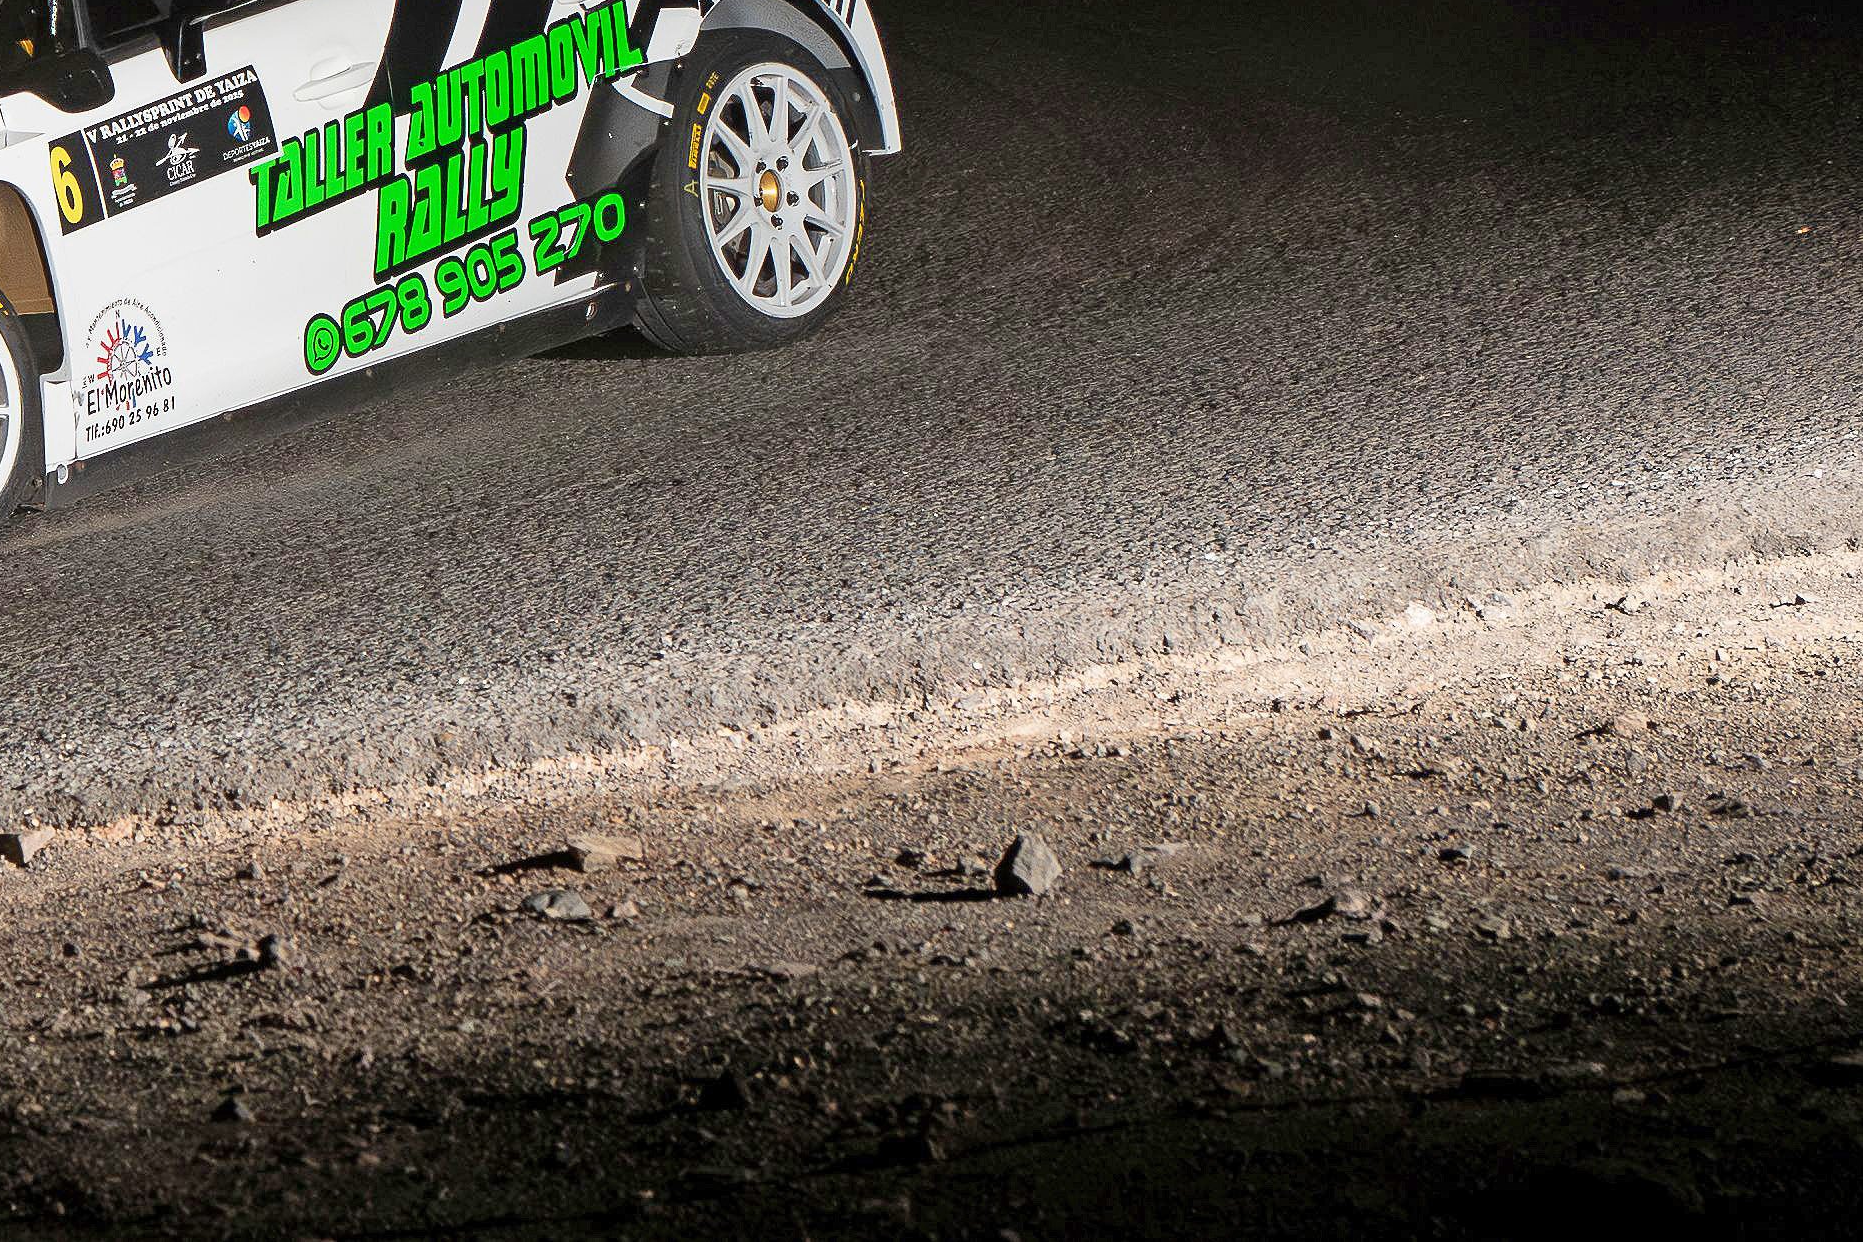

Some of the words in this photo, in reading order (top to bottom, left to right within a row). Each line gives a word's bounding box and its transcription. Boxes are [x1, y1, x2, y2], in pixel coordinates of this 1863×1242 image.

[86, 129, 97, 144] V
[100, 92, 193, 139] RALLYSPRINT
[194, 85, 216, 103] DE
[214, 70, 258, 94] YAIZA
[148, 122, 160, 132] de
[160, 103, 210, 127] noviembre
[210, 99, 223, 108] de
[222, 89, 244, 104] 2025
[251, 103, 393, 230] TALLER
[406, 0, 644, 162] AUTOMOVIL
[50, 146, 83, 224] 6
[167, 160, 195, 181] CICAR
[374, 126, 523, 273] RALLY
[343, 275, 429, 356] 678
[436, 232, 524, 315] 905
[529, 192, 626, 275] 270
[87, 388, 100, 416] El
[106, 365, 172, 409] Morenito
[129, 408, 142, 426] 25
[146, 403, 159, 419] 96
[163, 396, 175, 413] 81
